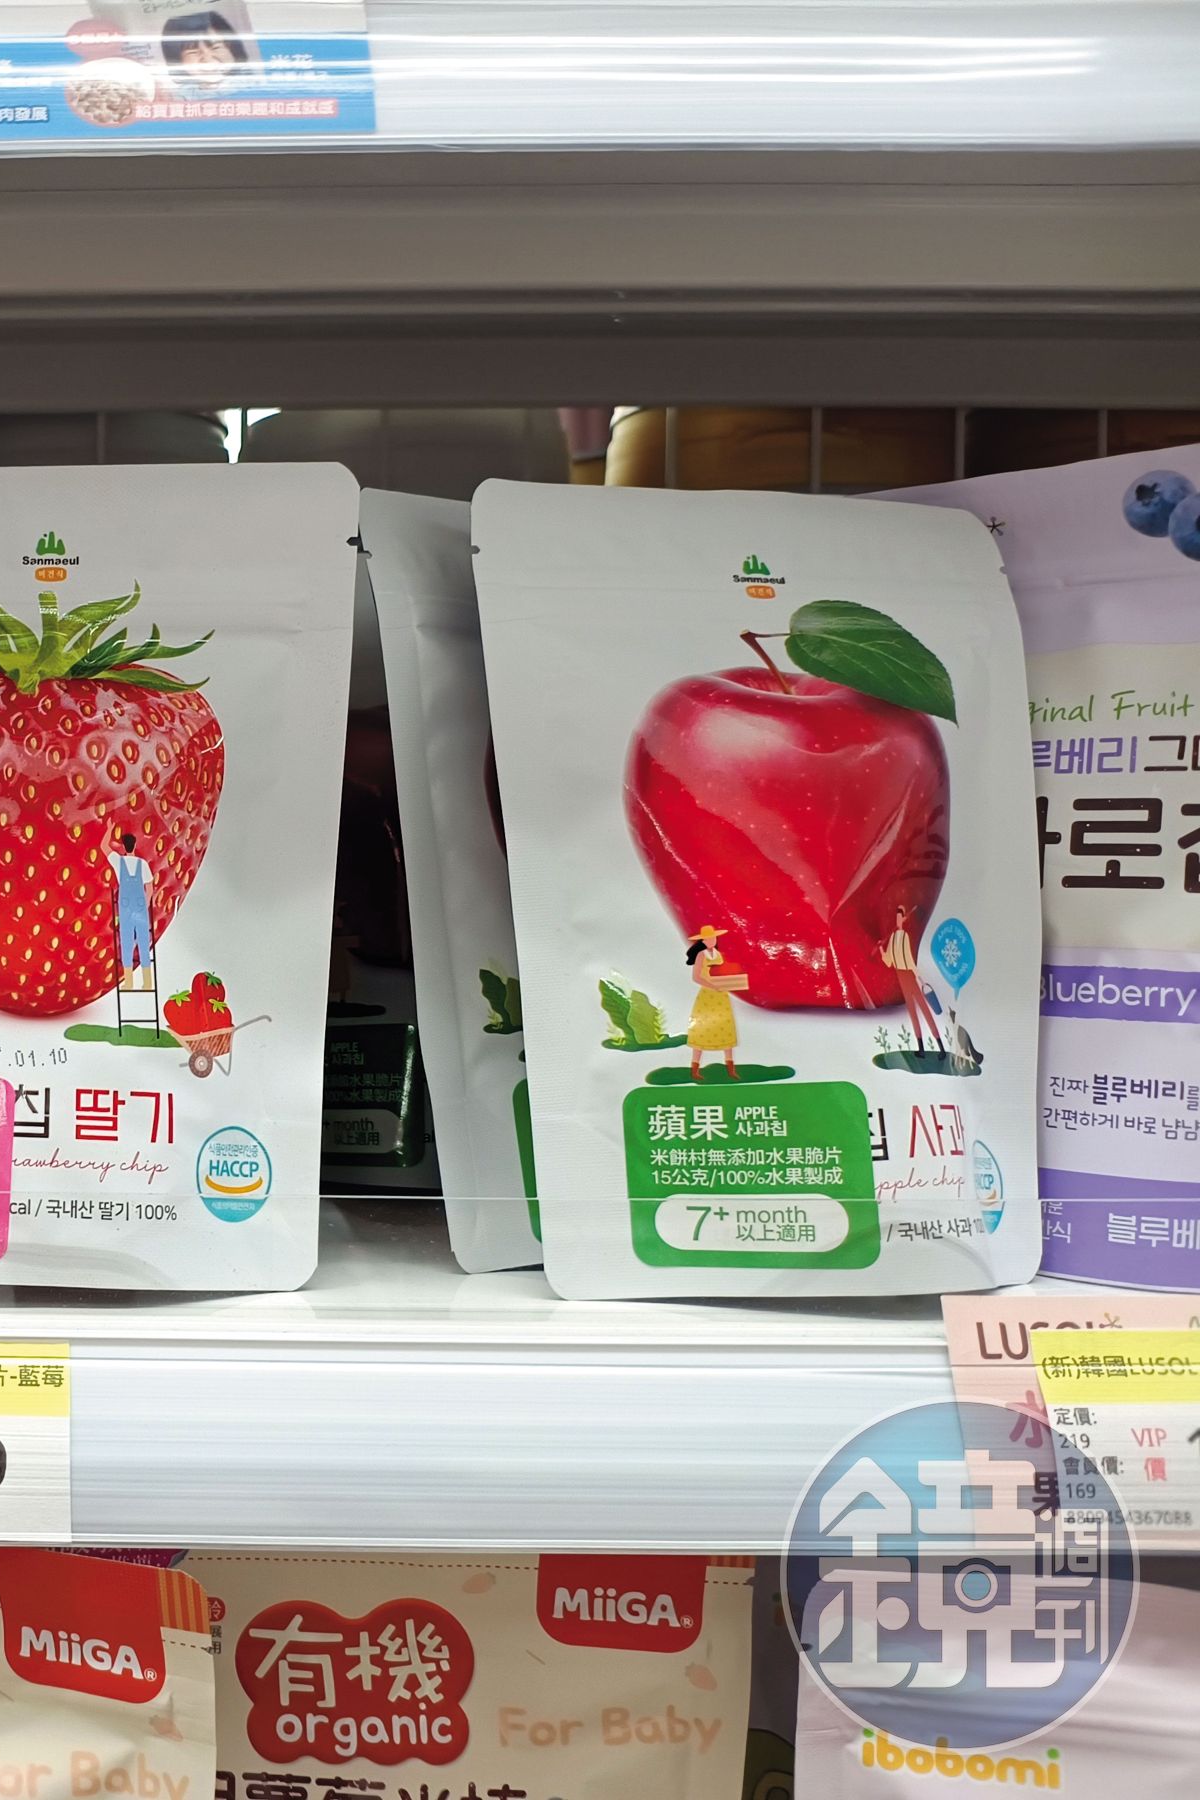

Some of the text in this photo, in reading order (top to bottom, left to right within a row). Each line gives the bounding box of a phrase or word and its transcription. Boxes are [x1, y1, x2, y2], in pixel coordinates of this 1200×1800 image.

[22, 555, 80, 566] Sanmaeul
[733, 574, 785, 584] Sanmaeul
[1111, 690, 1194, 721] Fruit
[1050, 1075, 1089, 1098] 진짜
[75, 1088, 174, 1144] 딸기
[648, 1105, 729, 1141] 蘋果
[735, 1106, 778, 1120] APPLE
[1043, 1107, 1119, 1131] 간편하게
[1124, 1116, 1156, 1135] 바로
[736, 1120, 788, 1137] 사과칩
[120, 1151, 170, 1185] chip
[650, 1146, 843, 1167] 米餅村無添加水果脆片
[209, 1159, 259, 1178] HACCP
[652, 1168, 843, 1187] 15公克/100%水果製成
[875, 1167, 928, 1204] pple
[46, 1199, 95, 1220] 국내산
[99, 1201, 130, 1221] 딸기
[135, 1203, 178, 1221] 100%
[736, 1206, 808, 1224] month
[736, 1224, 816, 1242] 以上適用
[898, 1219, 944, 1241] 국내산
[947, 1217, 972, 1237] 사과
[1054, 1407, 1098, 1426] 定價:
[1058, 1433, 1091, 1449] 219
[1131, 1428, 1168, 1447] VIP
[1065, 1483, 1096, 1499] 169
[552, 1587, 681, 1628] MiiGA
[19, 1626, 143, 1680] MiiGA
[249, 1615, 450, 1708] 有機
[275, 1703, 453, 1756] organic
[498, 1705, 722, 1754] For Baby
[861, 1728, 1062, 1790] ibobomi
[69, 1751, 190, 1800] Baby
